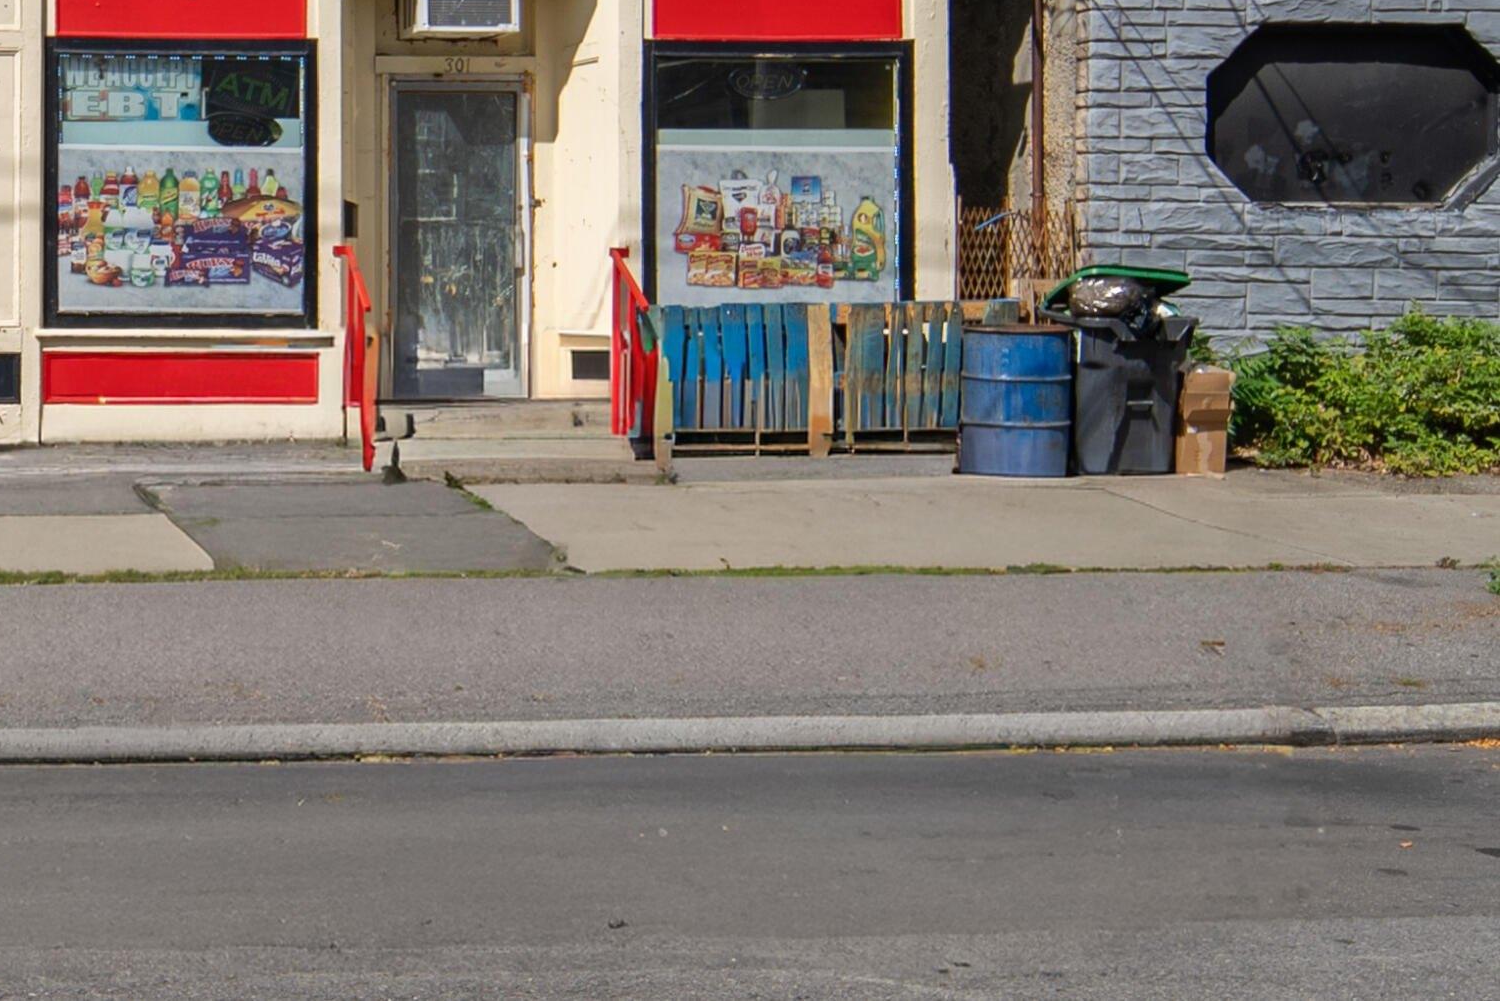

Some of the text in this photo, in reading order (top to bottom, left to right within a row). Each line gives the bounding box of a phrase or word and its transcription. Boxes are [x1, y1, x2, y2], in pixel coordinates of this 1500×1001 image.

[444, 57, 471, 74] 301
[69, 88, 183, 119] EBT
[215, 72, 290, 111] ATM
